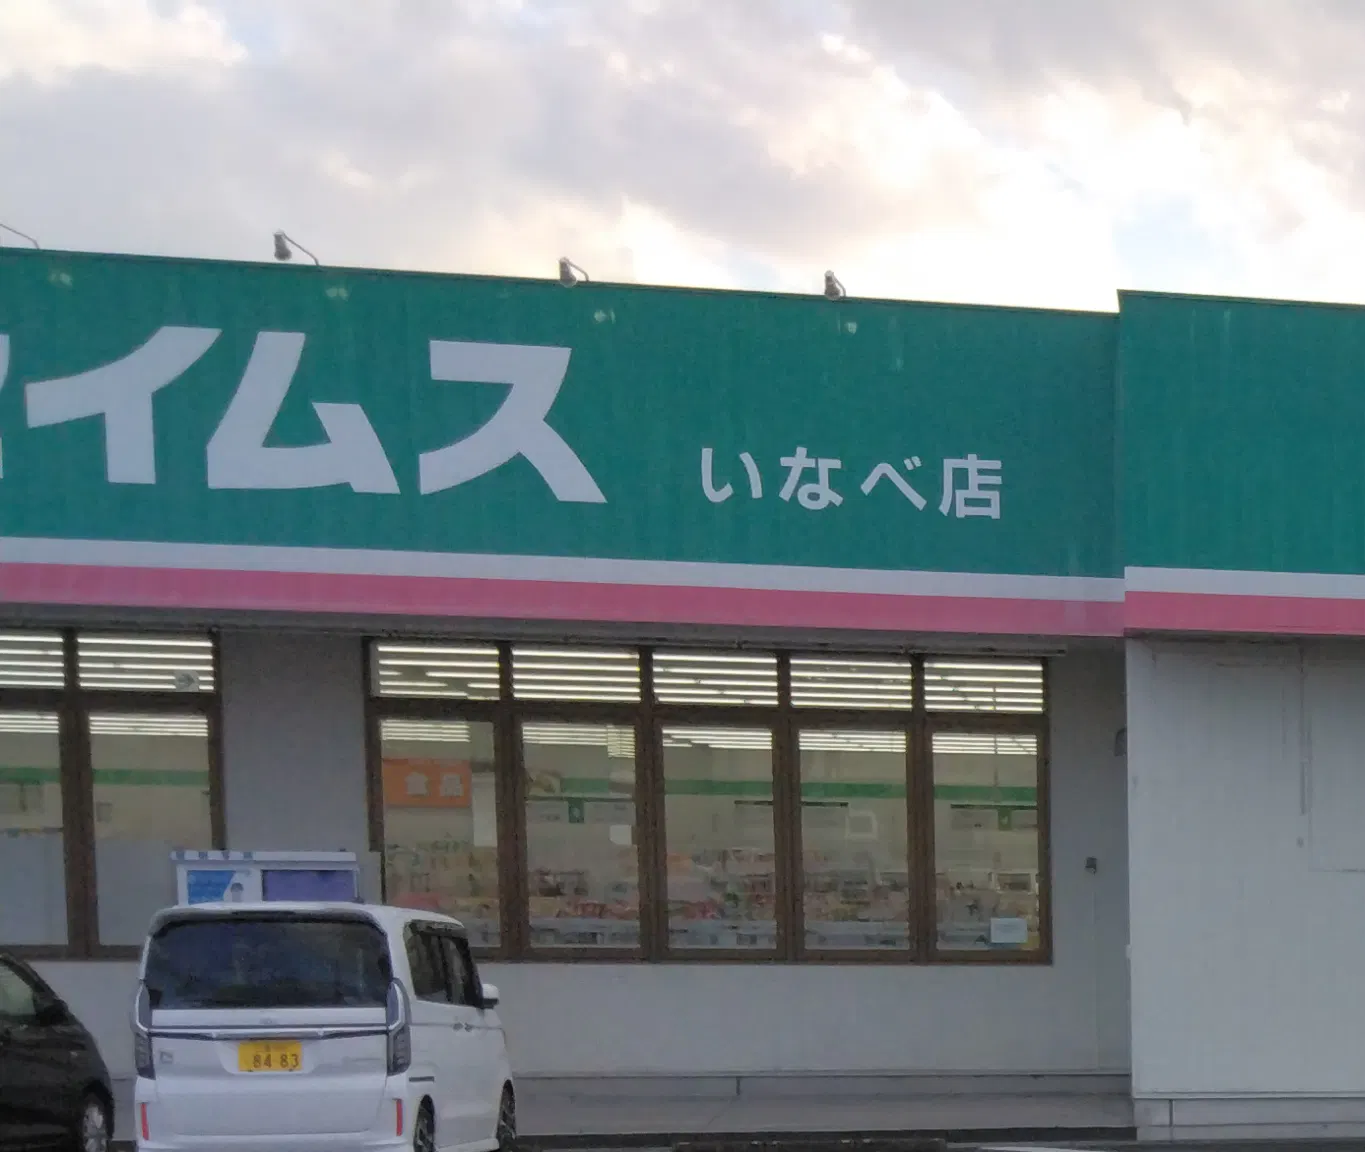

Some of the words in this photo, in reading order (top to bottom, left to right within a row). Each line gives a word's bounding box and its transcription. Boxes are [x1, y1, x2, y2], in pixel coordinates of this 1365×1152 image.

[0, 325, 608, 505] イムス
[701, 446, 1003, 520] いなべ店
